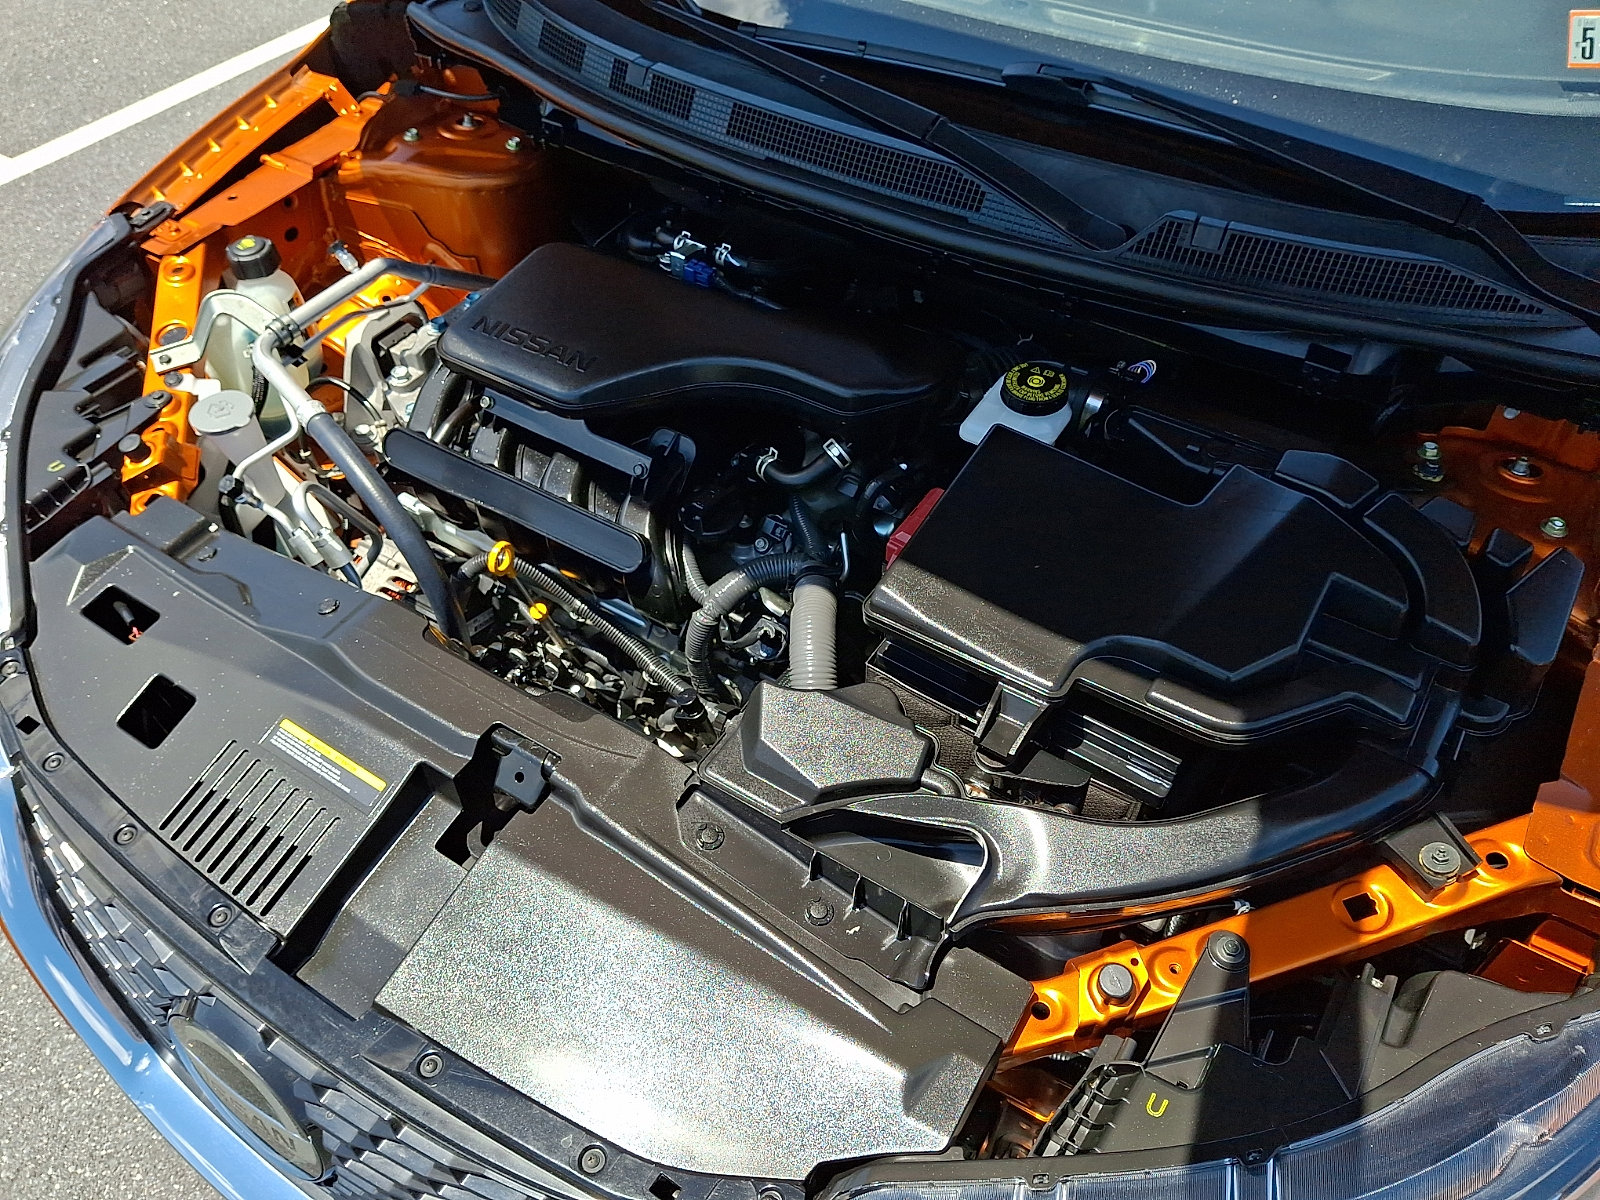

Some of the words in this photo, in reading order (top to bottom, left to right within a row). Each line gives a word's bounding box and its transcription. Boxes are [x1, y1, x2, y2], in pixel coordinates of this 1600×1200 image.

[1581, 26, 1596, 60] 5
[470, 315, 599, 373] NISSAN
[1146, 1091, 1169, 1118] U
